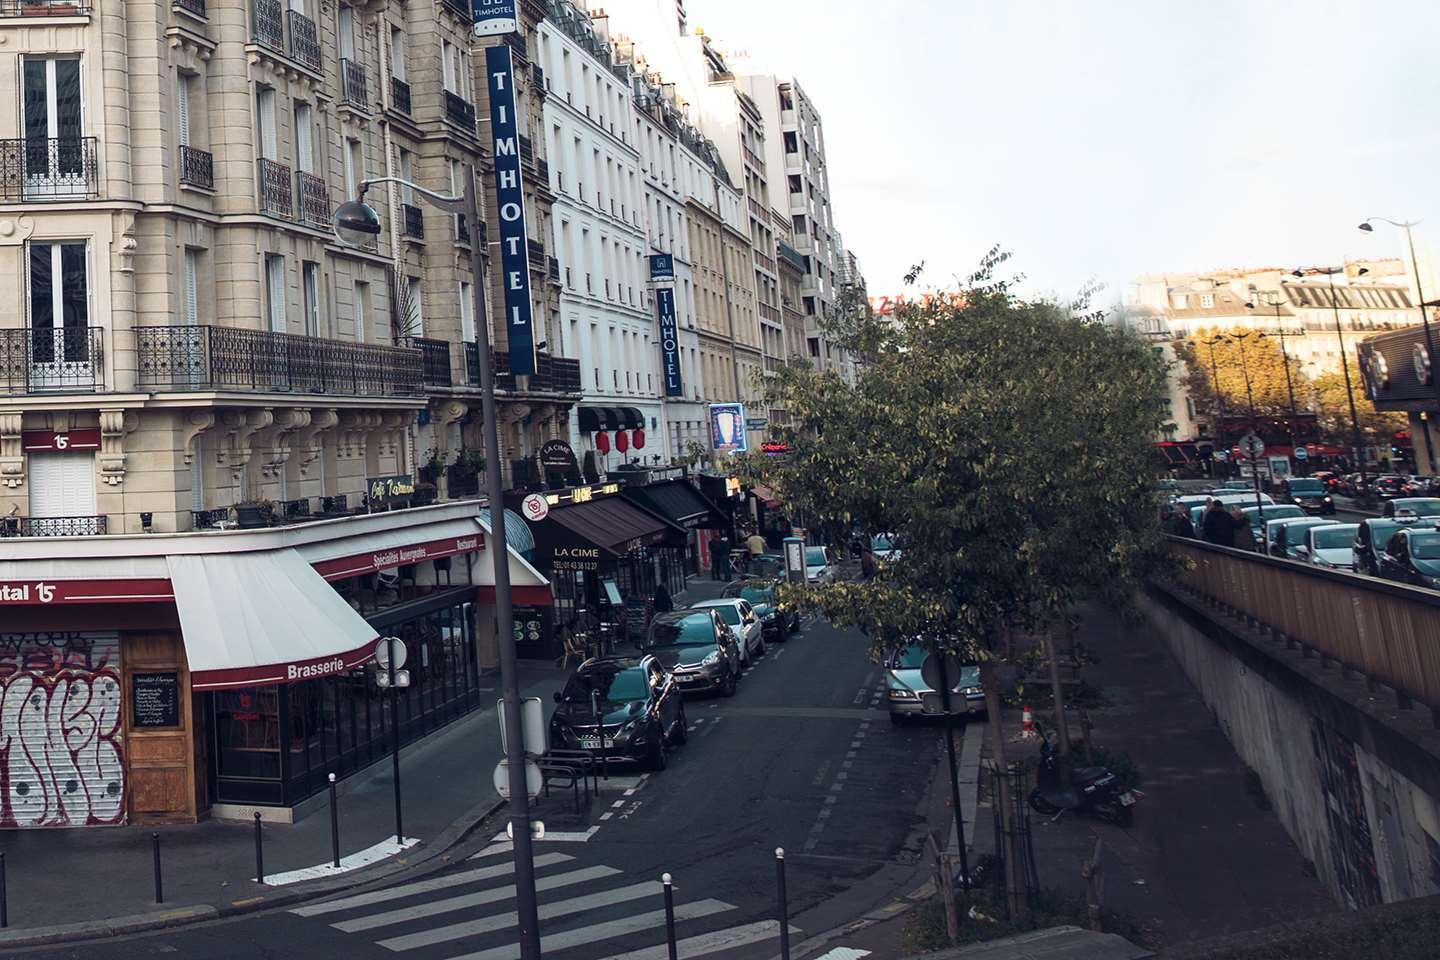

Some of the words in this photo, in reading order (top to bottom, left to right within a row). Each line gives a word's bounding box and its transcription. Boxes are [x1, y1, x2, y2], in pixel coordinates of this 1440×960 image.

[474, 6, 513, 16] TIMHOTEL
[493, 72, 526, 325] TIMHOTEL
[660, 290, 677, 388] TIMHOTEL
[54, 434, 69, 449] 15
[554, 548, 569, 557] LA
[570, 548, 599, 558] CIME
[35, 582, 56, 603] 15
[287, 658, 344, 680] Brasserie
